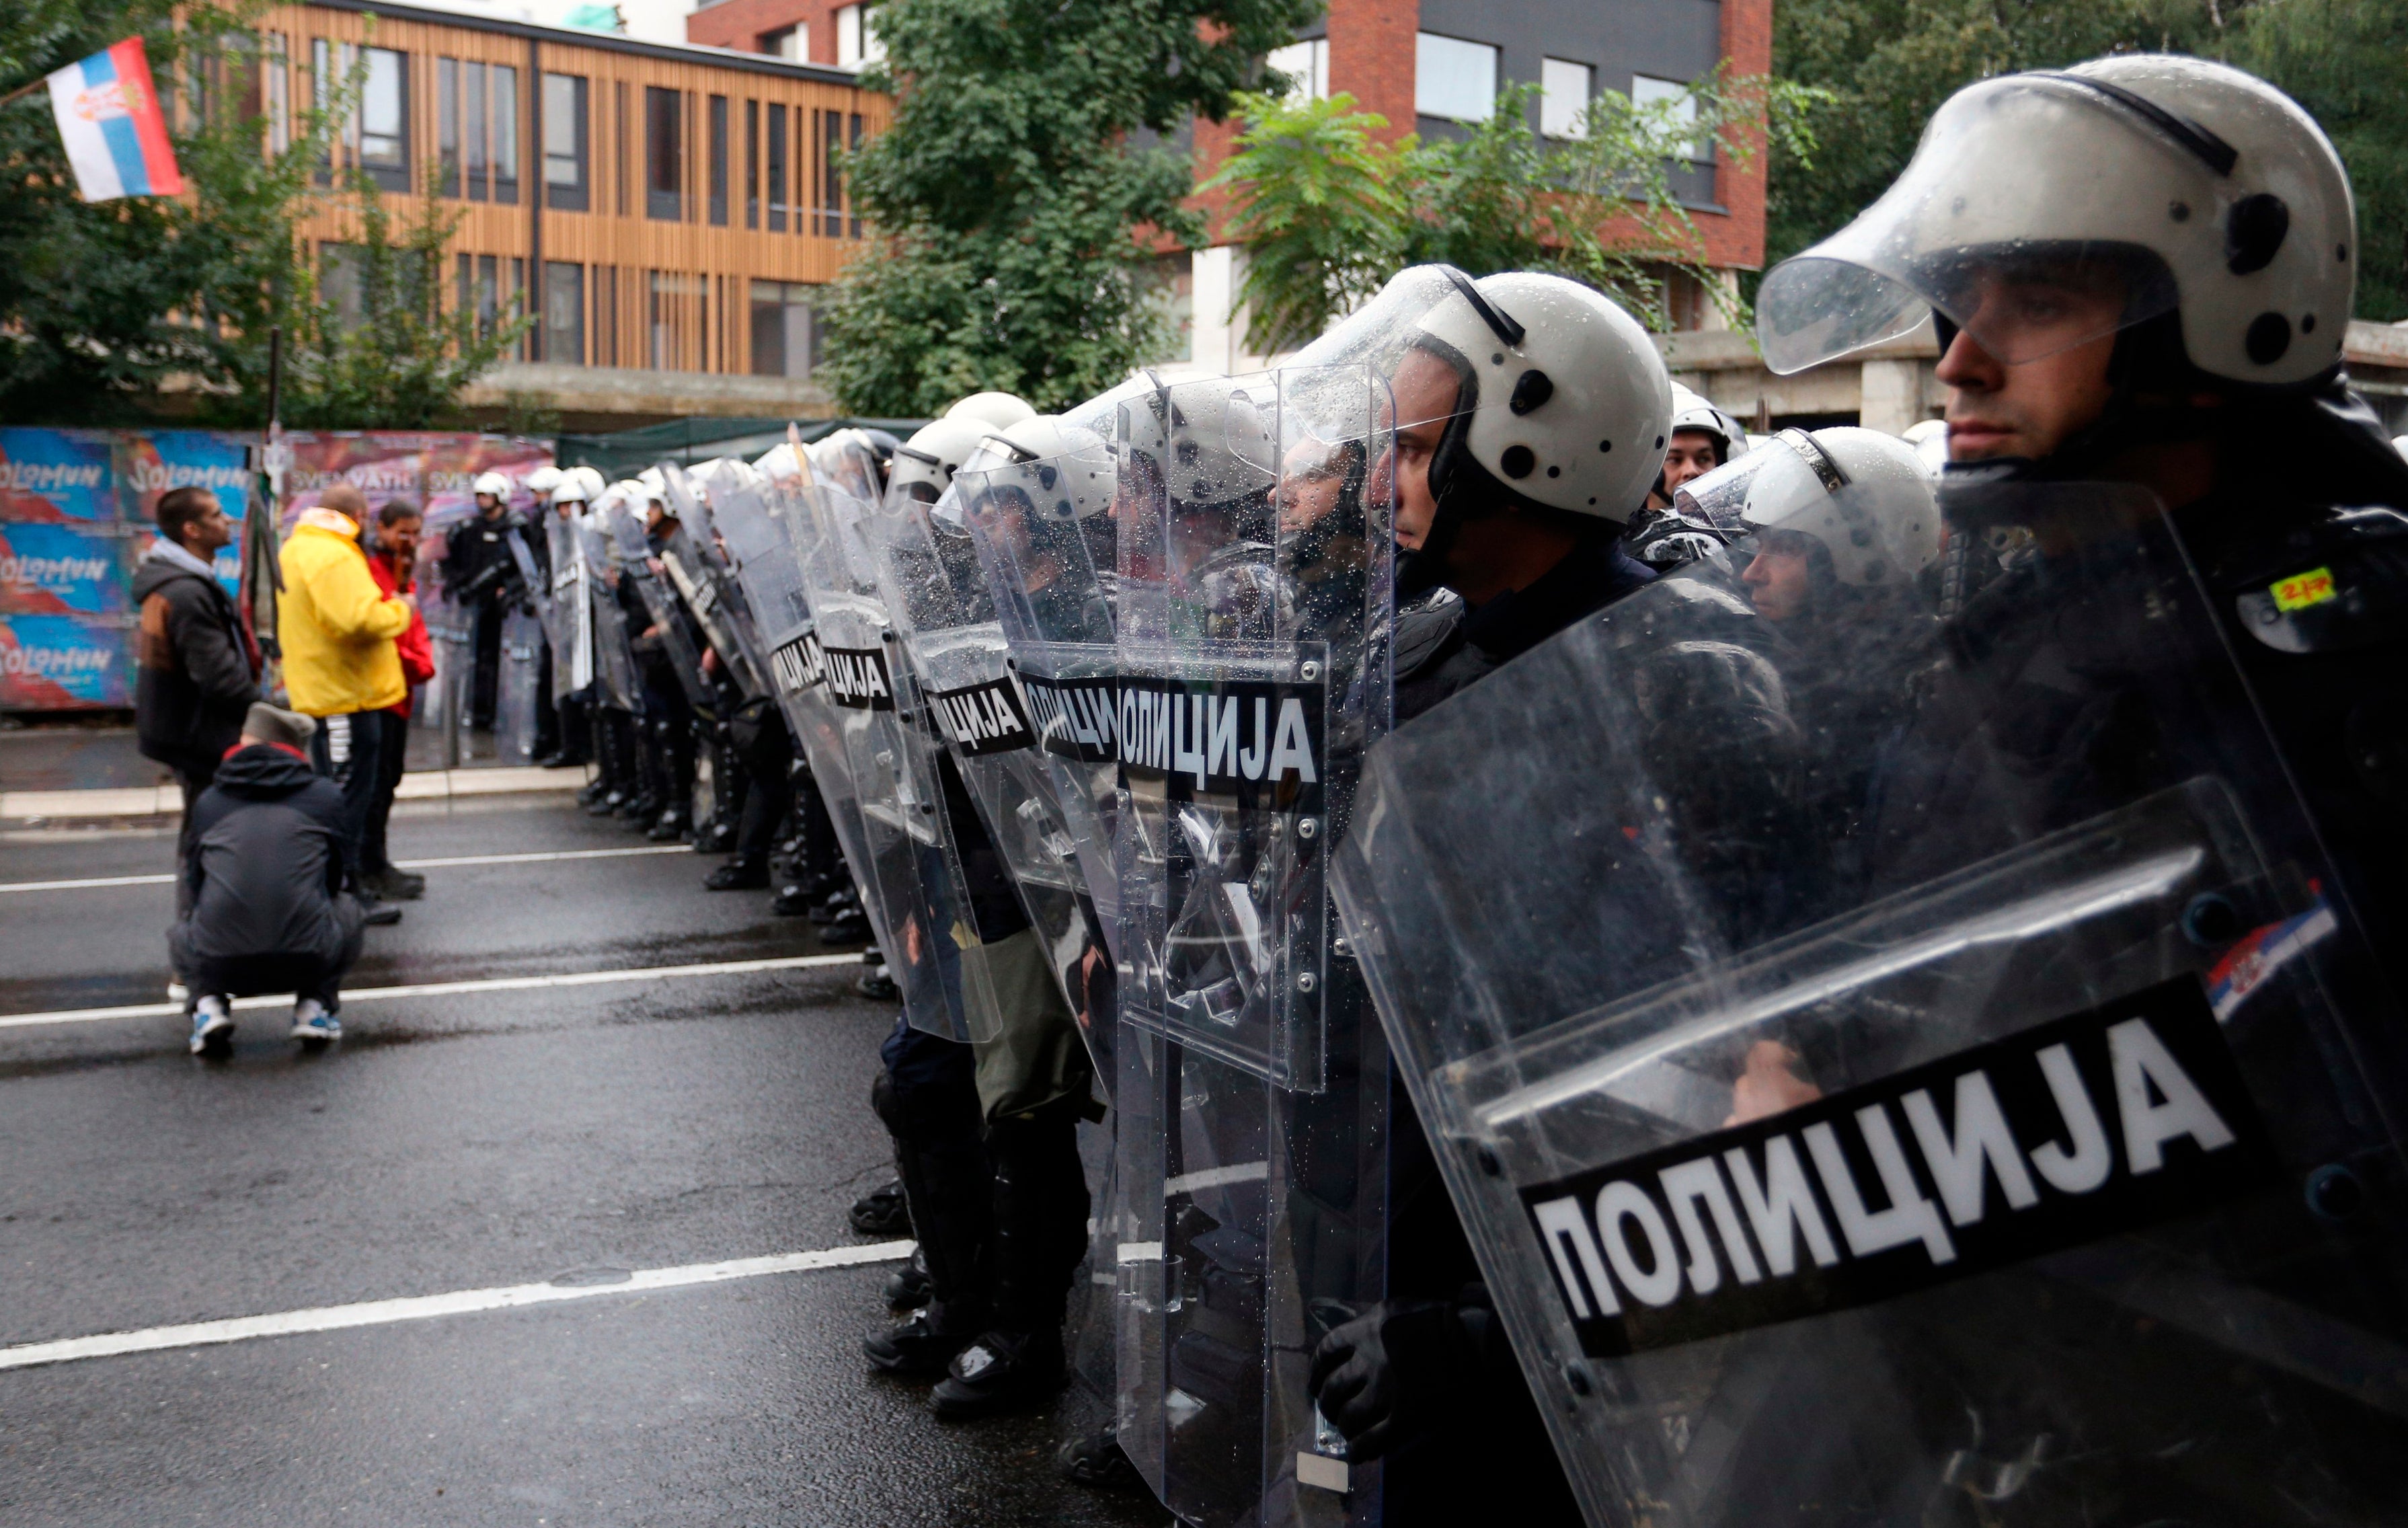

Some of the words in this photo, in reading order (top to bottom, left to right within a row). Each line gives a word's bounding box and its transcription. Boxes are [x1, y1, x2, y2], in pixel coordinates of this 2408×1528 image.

[0, 459, 104, 490] OLOMUN
[0, 553, 109, 583] OLOMUN
[776, 636, 824, 689] ЦИЈА
[826, 652, 888, 703] ЦИЈА
[941, 687, 1024, 751] ЦИЈА
[1025, 681, 1118, 755] ОЛИЦИ
[1117, 687, 1317, 792] ОЛИЦИЈА
[1534, 1016, 2236, 1320] ПОЛИЦИЈА
